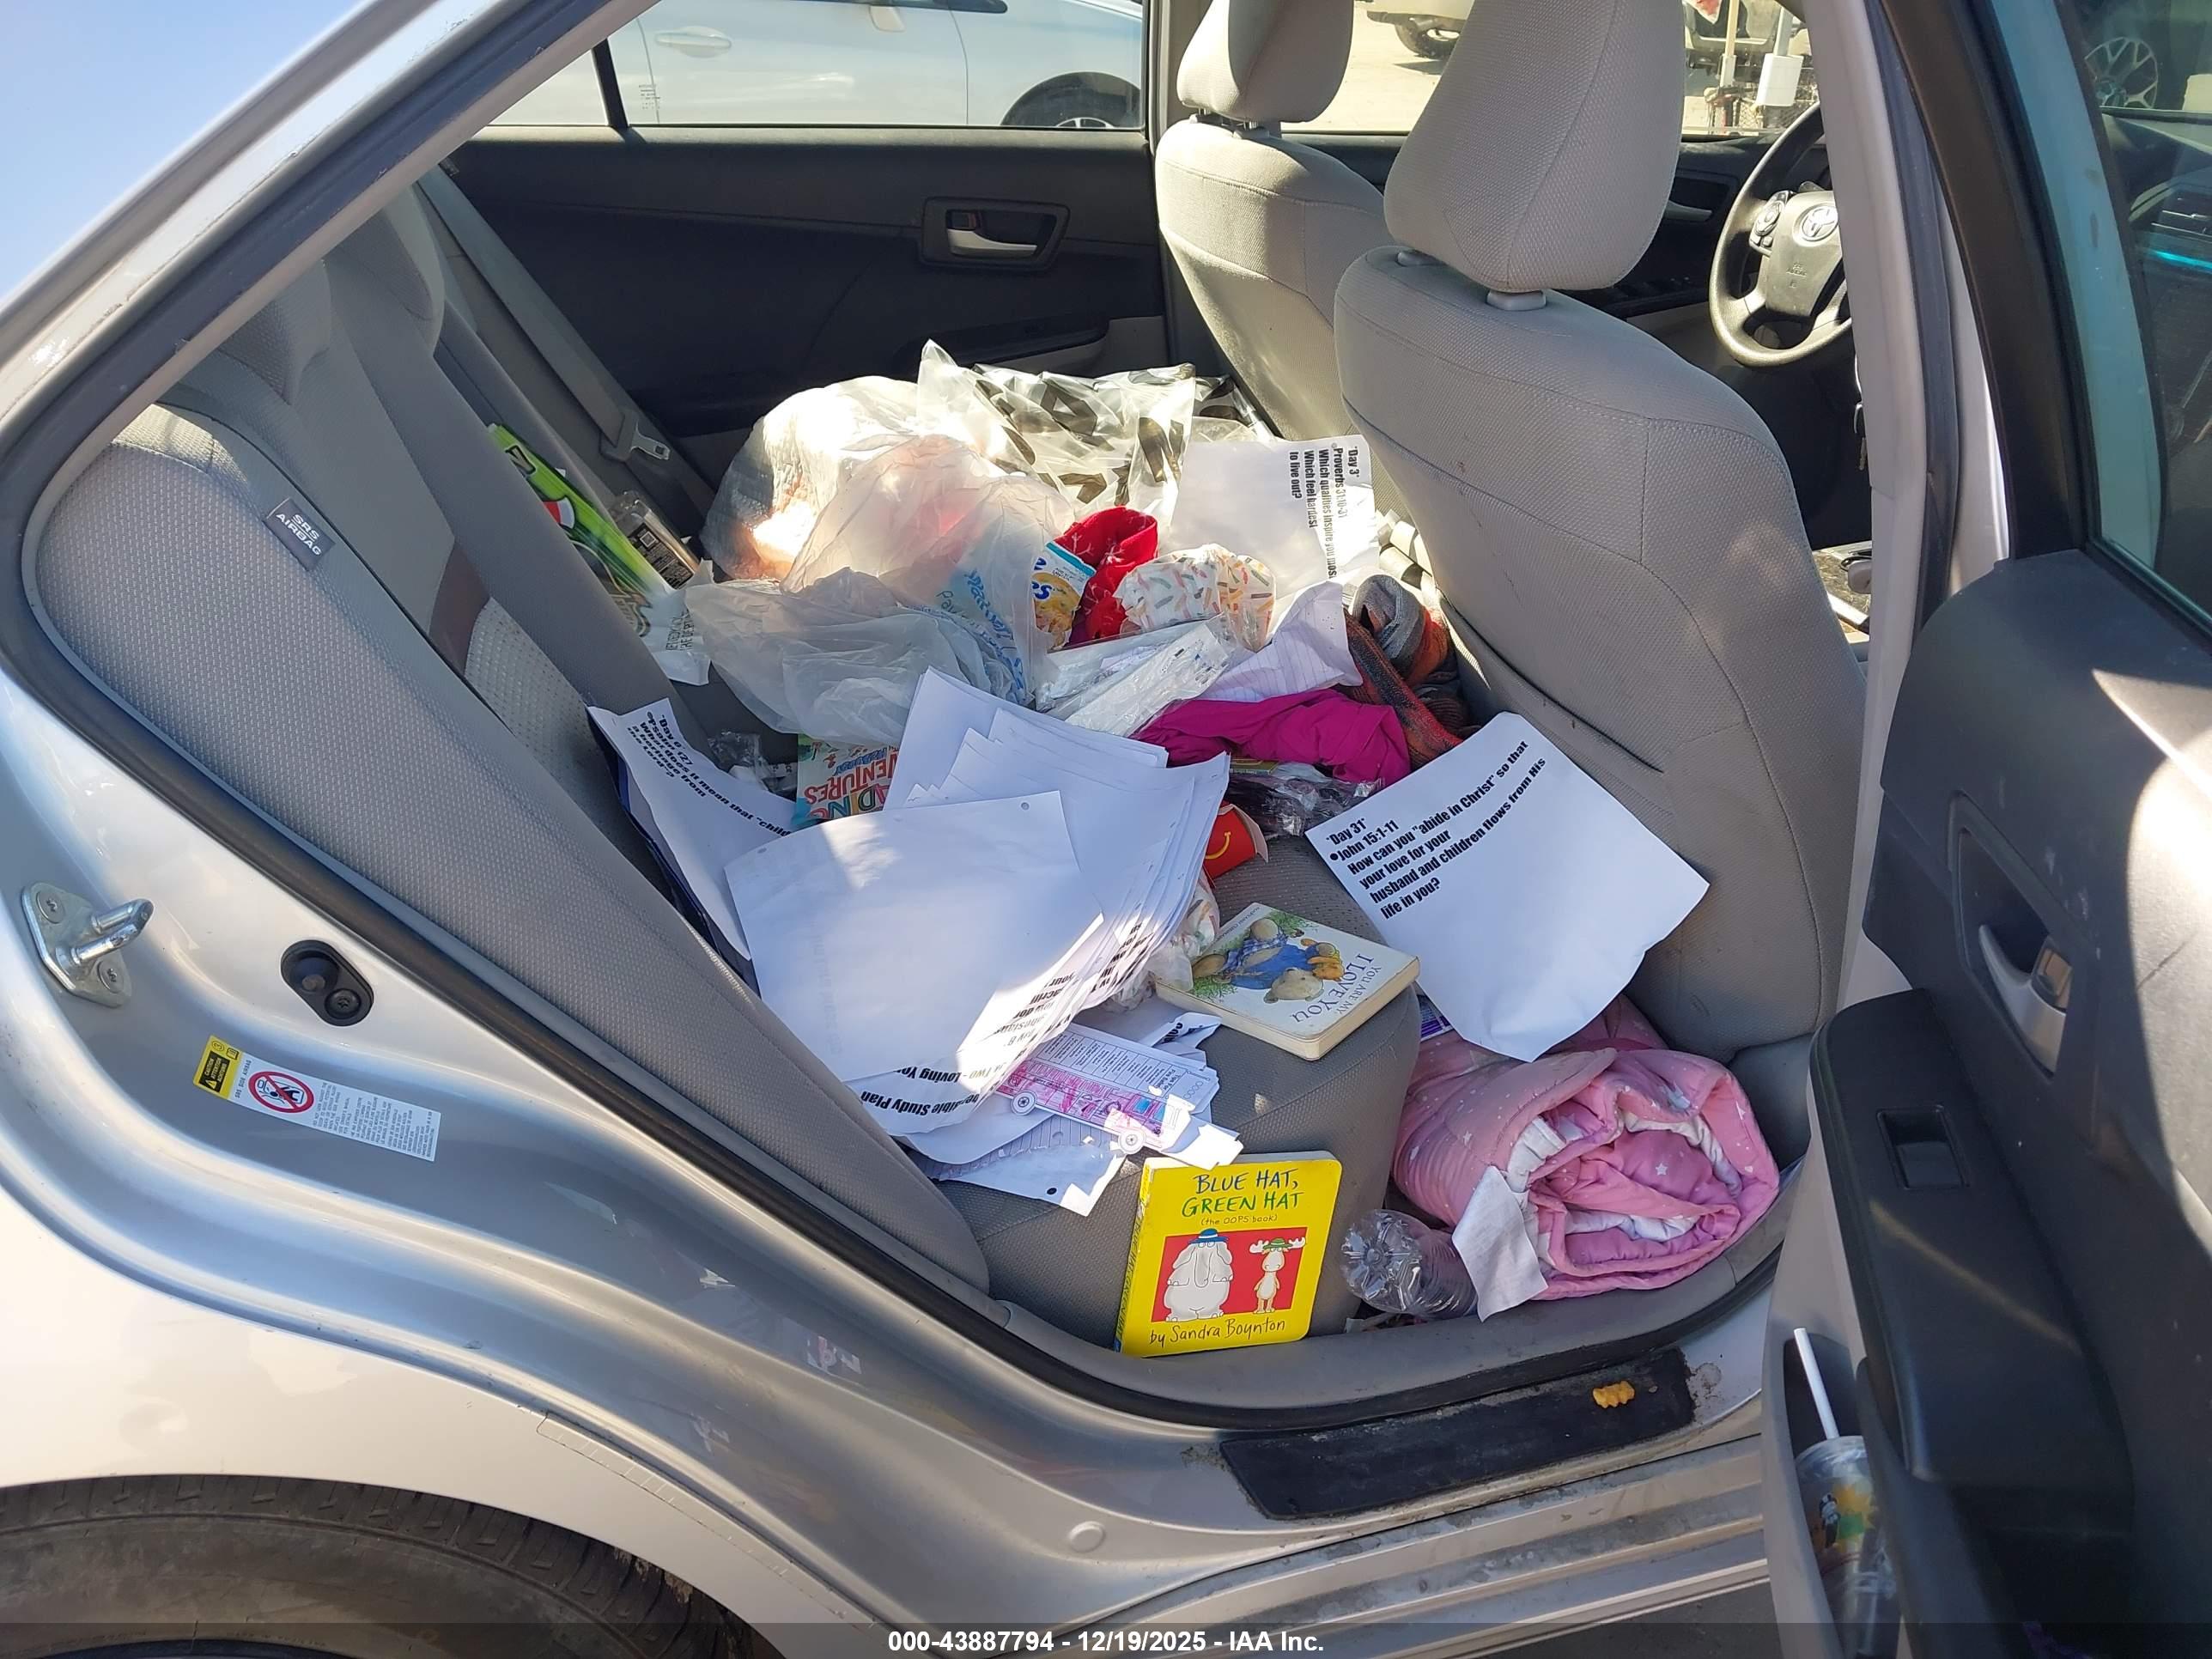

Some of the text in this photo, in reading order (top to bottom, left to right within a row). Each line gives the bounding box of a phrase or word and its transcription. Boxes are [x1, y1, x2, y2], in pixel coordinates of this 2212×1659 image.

[1290, 452, 1303, 499] to live out?
[1304, 450, 1316, 479] Which
[1319, 449, 1330, 477] Which
[1333, 448, 1345, 488] Proverbs
[1305, 479, 1316, 496] feel
[276, 514, 322, 556] AIRBAG
[292, 514, 319, 540] SRS
[640, 722, 664, 750] What
[665, 750, 690, 773] does
[690, 772, 699, 781] it
[699, 781, 730, 805] mean
[730, 804, 754, 821] that
[680, 774, 708, 797] from
[1347, 740, 1528, 875] How can you "abide in Christ" so that
[1338, 819, 1400, 862] John 15:1-11
[1370, 757, 1546, 903] husband and children flows from His
[1359, 830, 1451, 890] your love for your
[1380, 877, 1441, 920] life in you?
[1291, 953, 1374, 1023] I LOVE YOU
[1362, 966, 1382, 983] YOU
[1349, 984, 1367, 1001] ARE
[204, 1058, 215, 1076] CAUTION
[210, 1058, 222, 1080] ATTENTION
[919, 1067, 962, 1084] Loving
[860, 1091, 893, 1109] Plan
[893, 1098, 931, 1116] Study
[1193, 1168, 1298, 1194] BLUE HAT,
[1182, 1191, 1304, 1218] GREEN HAT
[1200, 1214, 1278, 1226] (the OOPS book)
[1150, 1317, 1286, 1348] by Sandra Boynton
